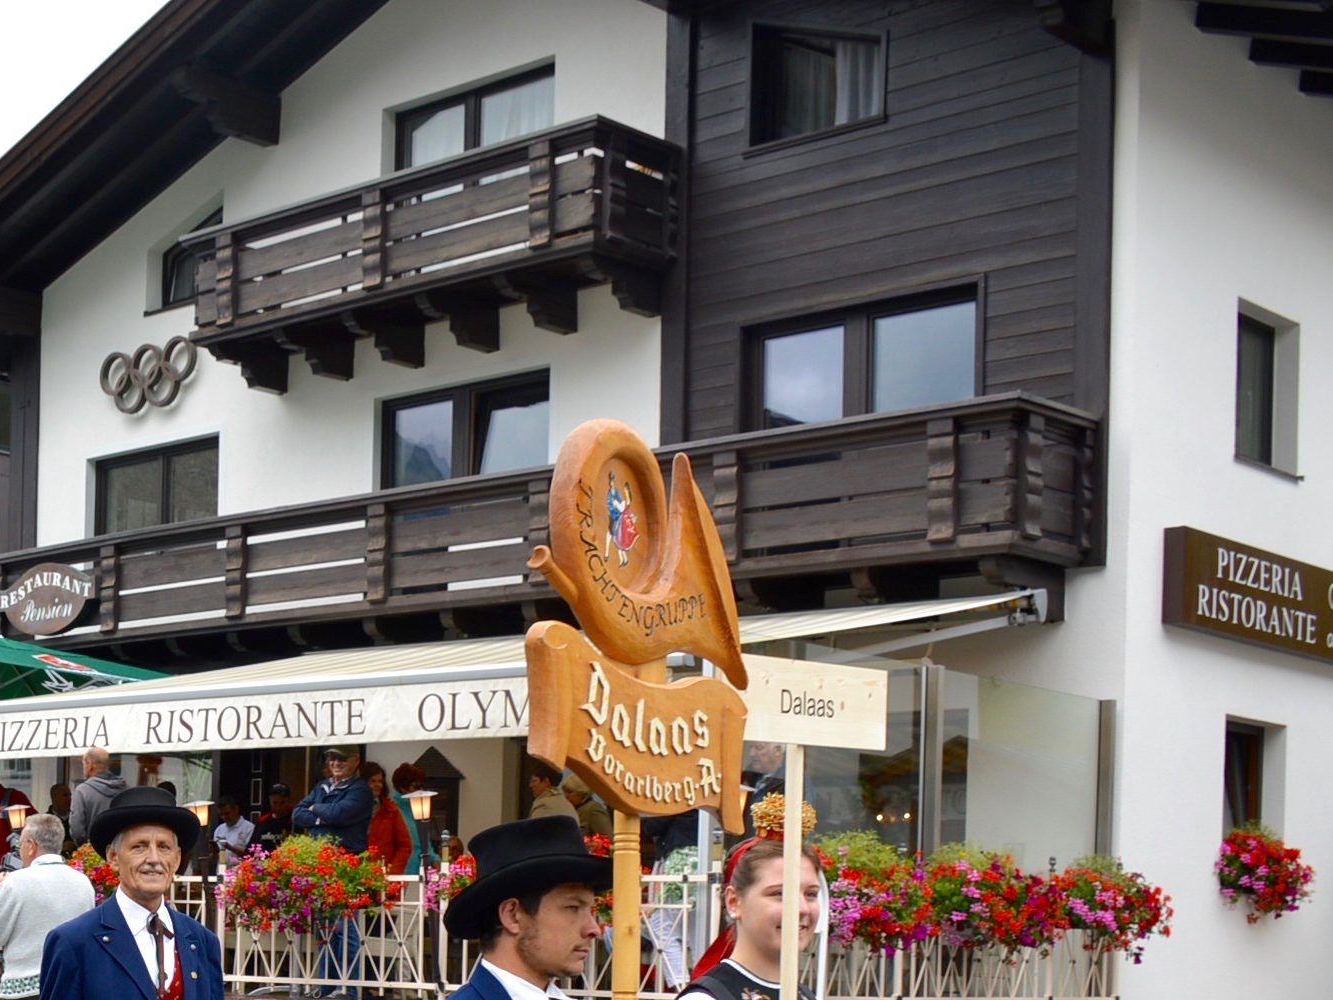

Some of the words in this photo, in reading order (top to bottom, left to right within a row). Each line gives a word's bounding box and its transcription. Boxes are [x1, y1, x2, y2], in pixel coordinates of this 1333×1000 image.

[576, 478, 707, 637] TRACHTENGRUPPE
[1216, 547, 1303, 601] PIZZERIA
[0, 571, 91, 609] RESTAURANT
[20, 597, 72, 622] Pension
[1197, 584, 1317, 645] RISTORANTE
[142, 698, 367, 746] RISTORANTE
[418, 688, 530, 733] OLYM
[579, 661, 710, 757] Dalaas
[780, 689, 834, 719] Dalaas
